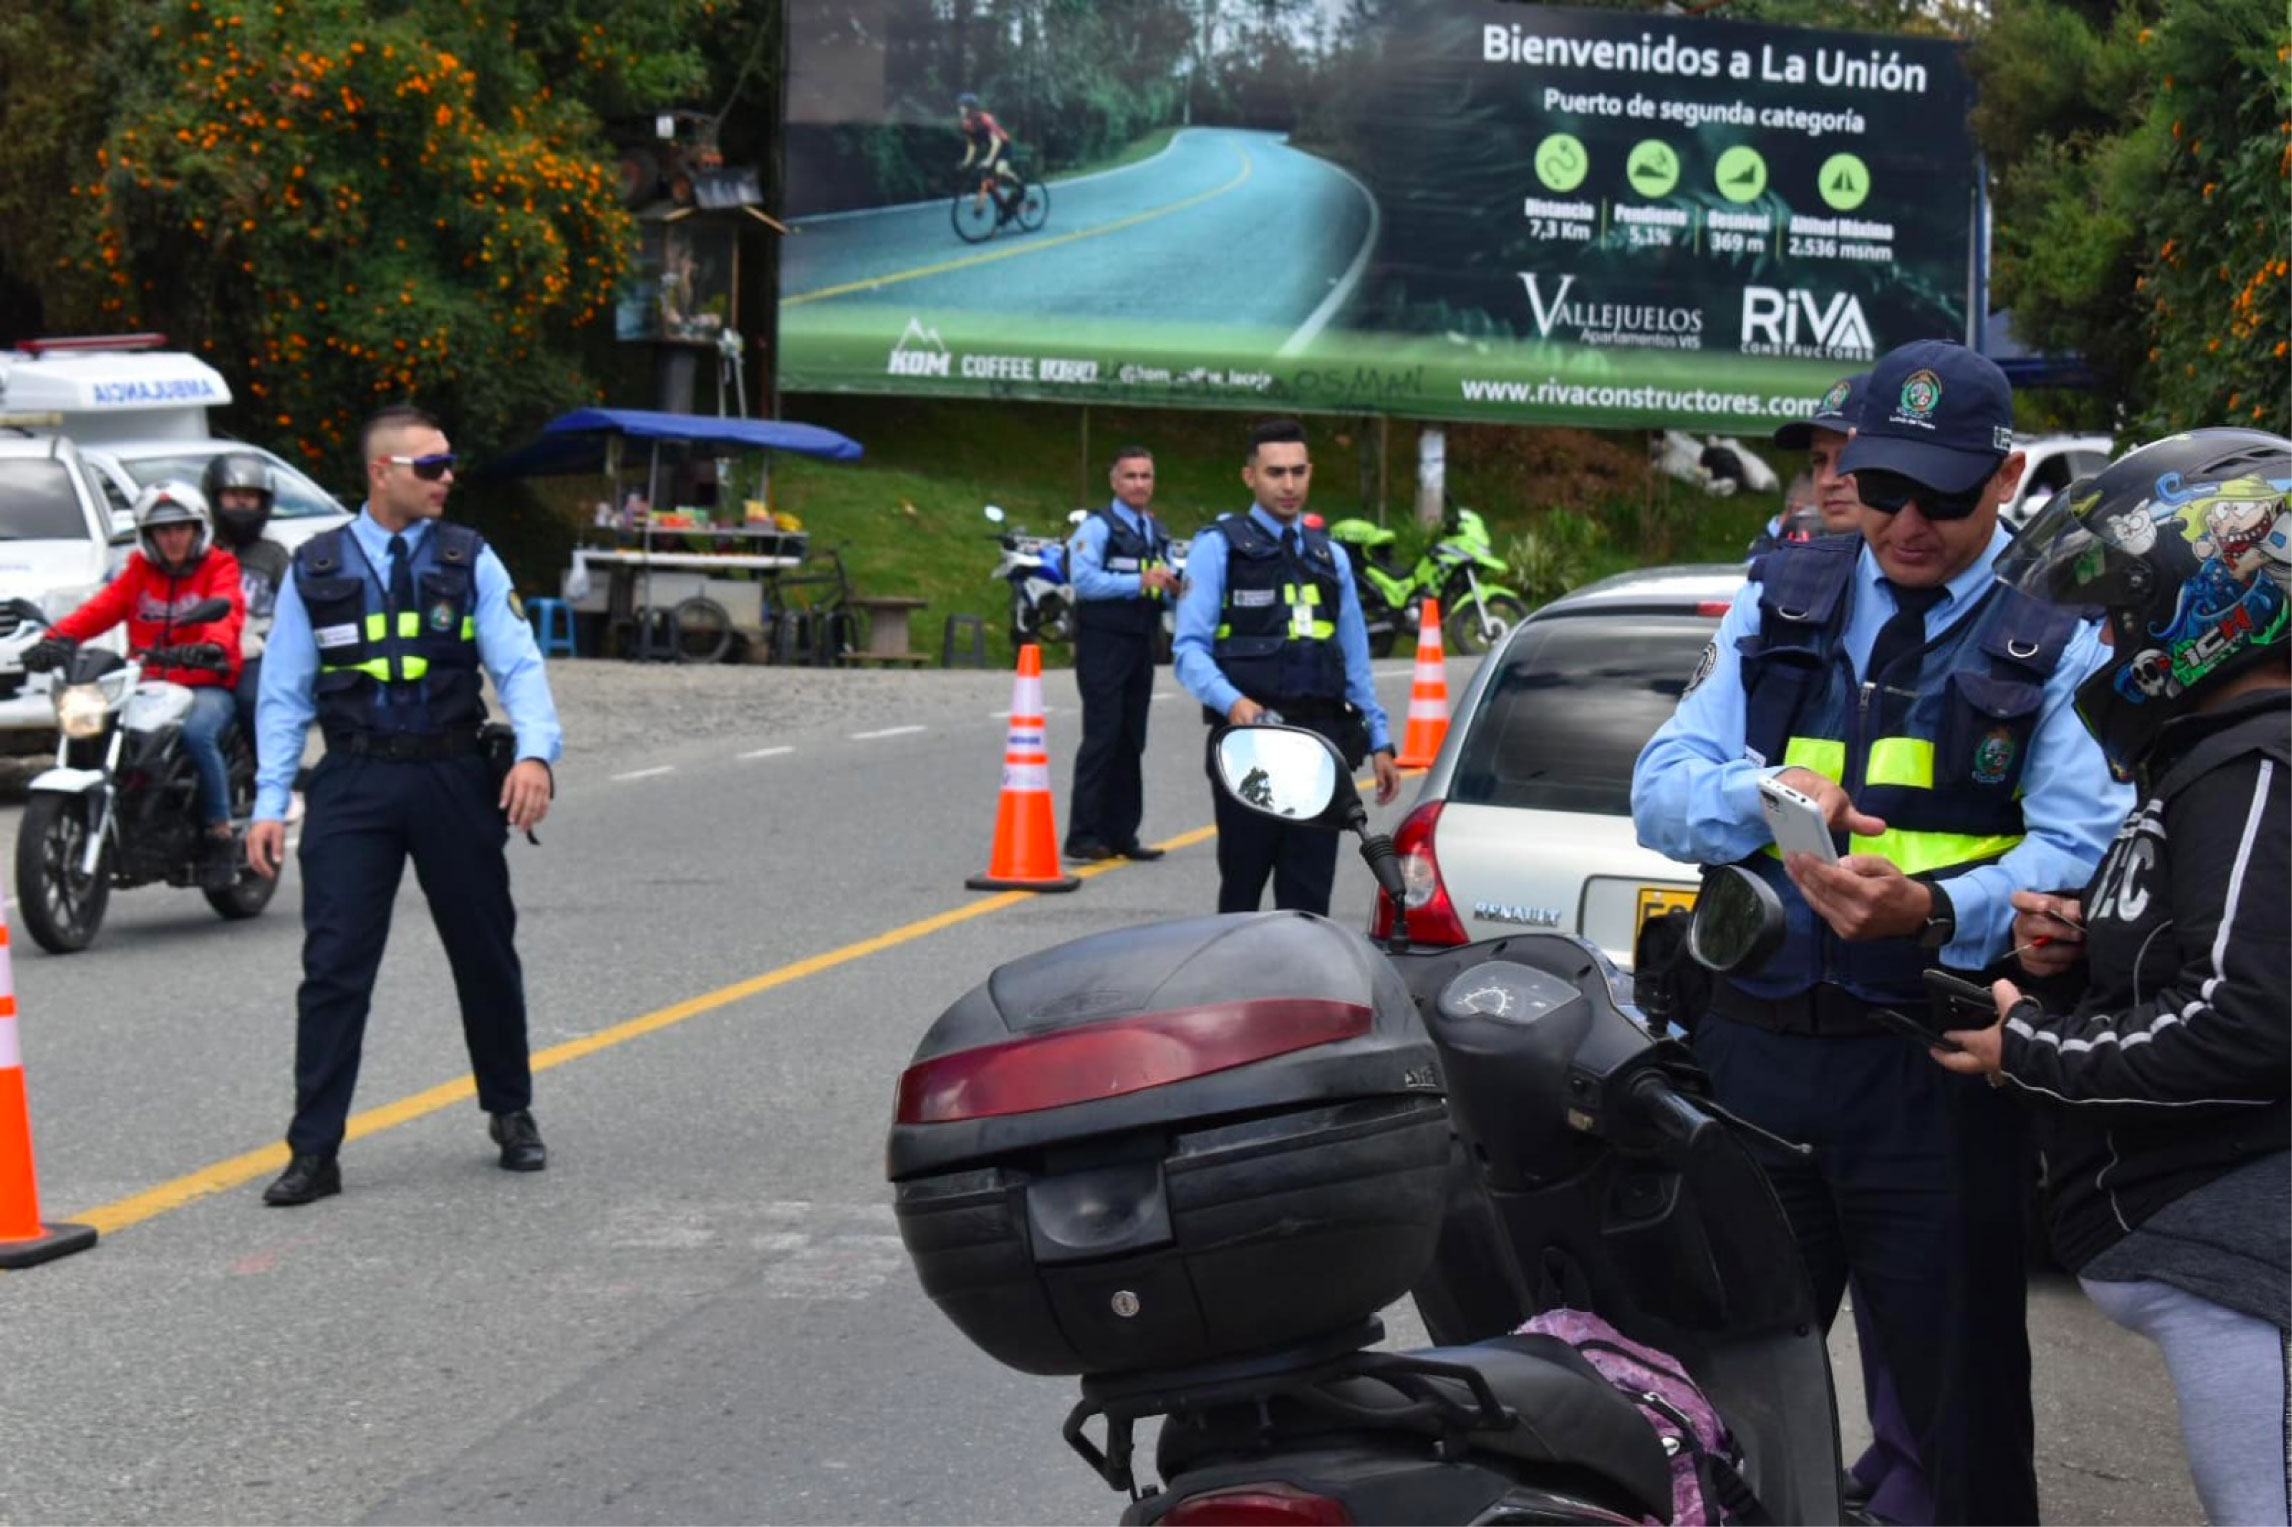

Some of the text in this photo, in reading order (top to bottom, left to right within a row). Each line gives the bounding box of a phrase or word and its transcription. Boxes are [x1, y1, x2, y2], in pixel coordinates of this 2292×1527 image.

[1483, 22, 1927, 93] Bienvenidos a La Unión
[1544, 88, 1866, 137] Puerto de segunda categoría
[1530, 218, 1592, 241] 7,3 Km
[1710, 231, 1766, 252] 369 m
[1788, 236, 1894, 262] 2.536 msnm
[1517, 271, 1703, 338] VALLEJUELOS
[1740, 341, 1875, 362] CONSTRUCTORES
[960, 353, 1033, 380] COFFEE
[1461, 377, 1821, 417] www.rivaconstructores.com
[1473, 900, 1562, 928] RENAULT
